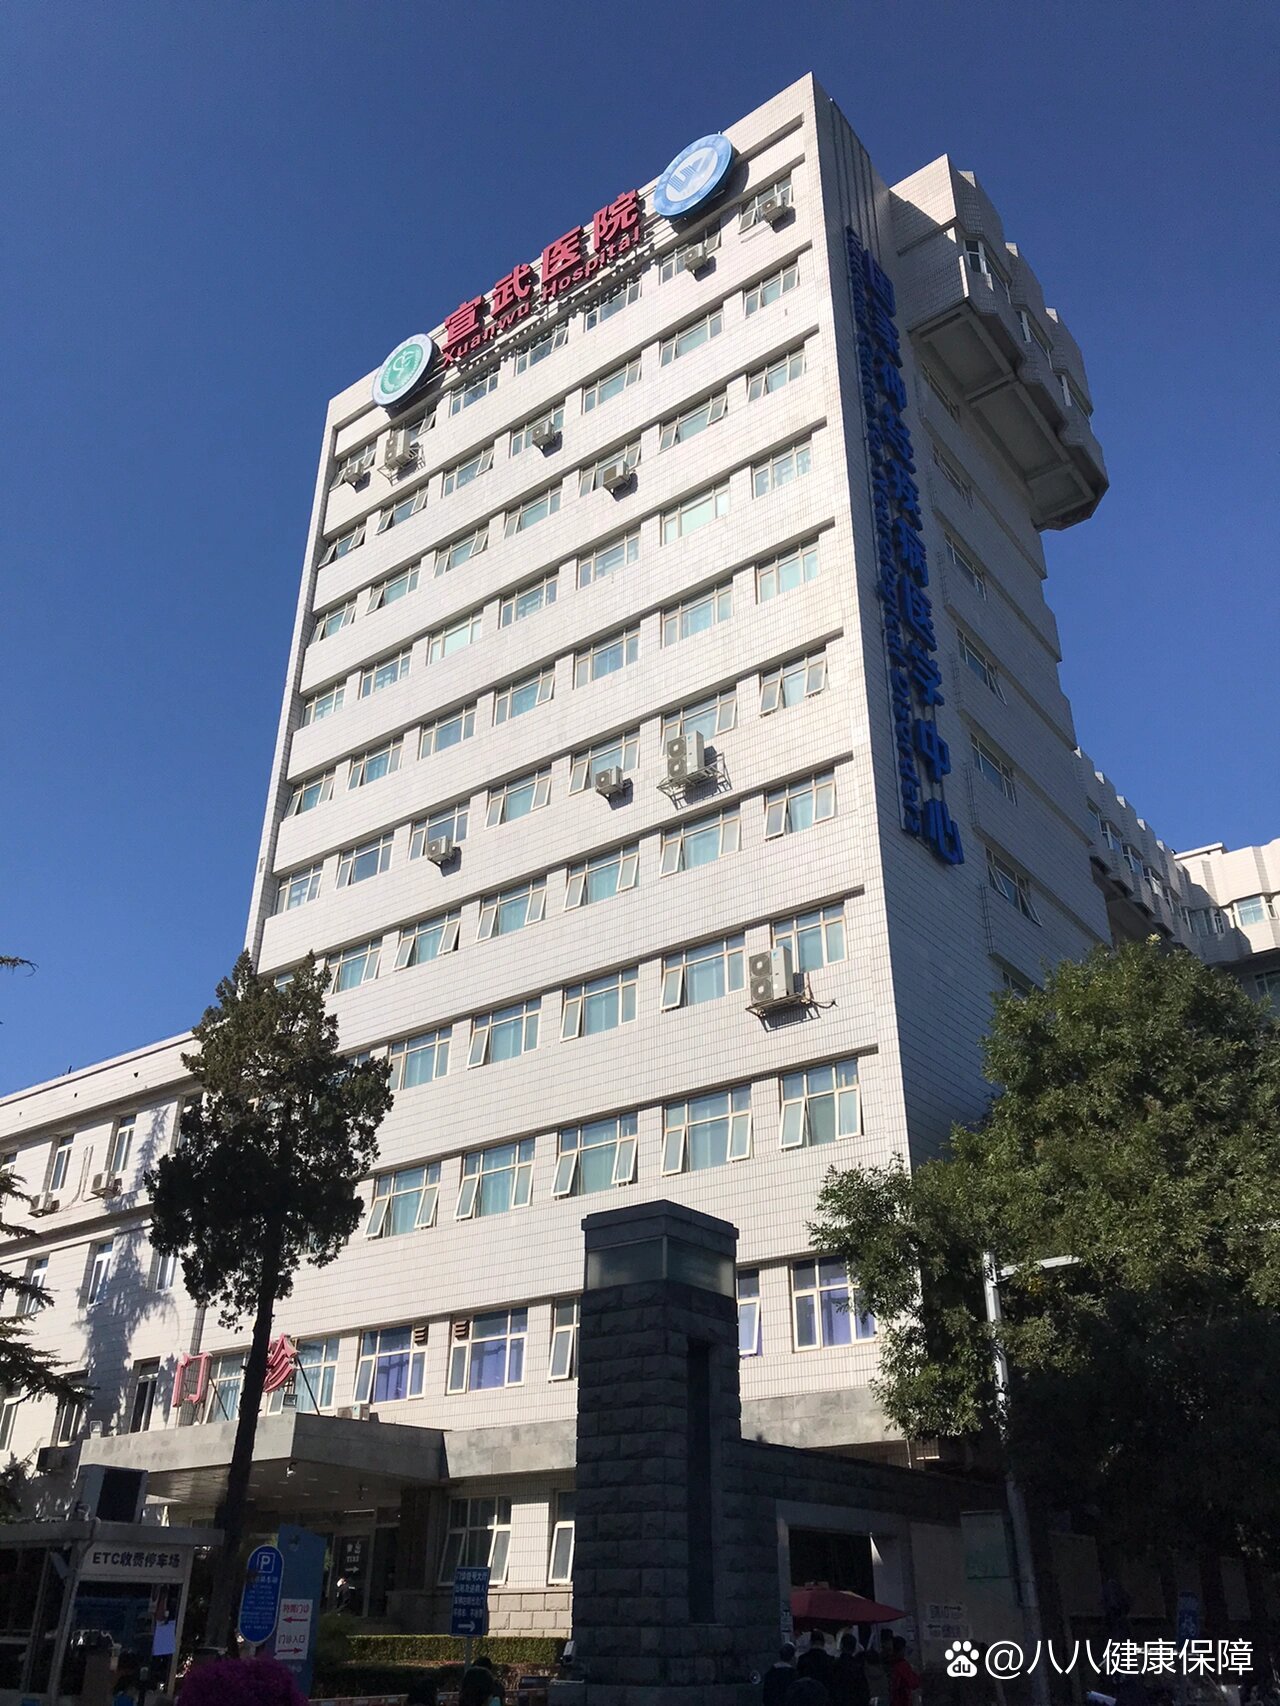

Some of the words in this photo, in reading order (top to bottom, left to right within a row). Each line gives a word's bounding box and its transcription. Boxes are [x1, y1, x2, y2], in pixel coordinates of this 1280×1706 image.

[440, 301, 531, 367] Xuanwu
[540, 226, 640, 302] Hospital
[443, 188, 638, 350] 宣武医院
[92, 1551, 181, 1568] ETC收费停车场
[278, 1634, 306, 1645] 门诊入口
